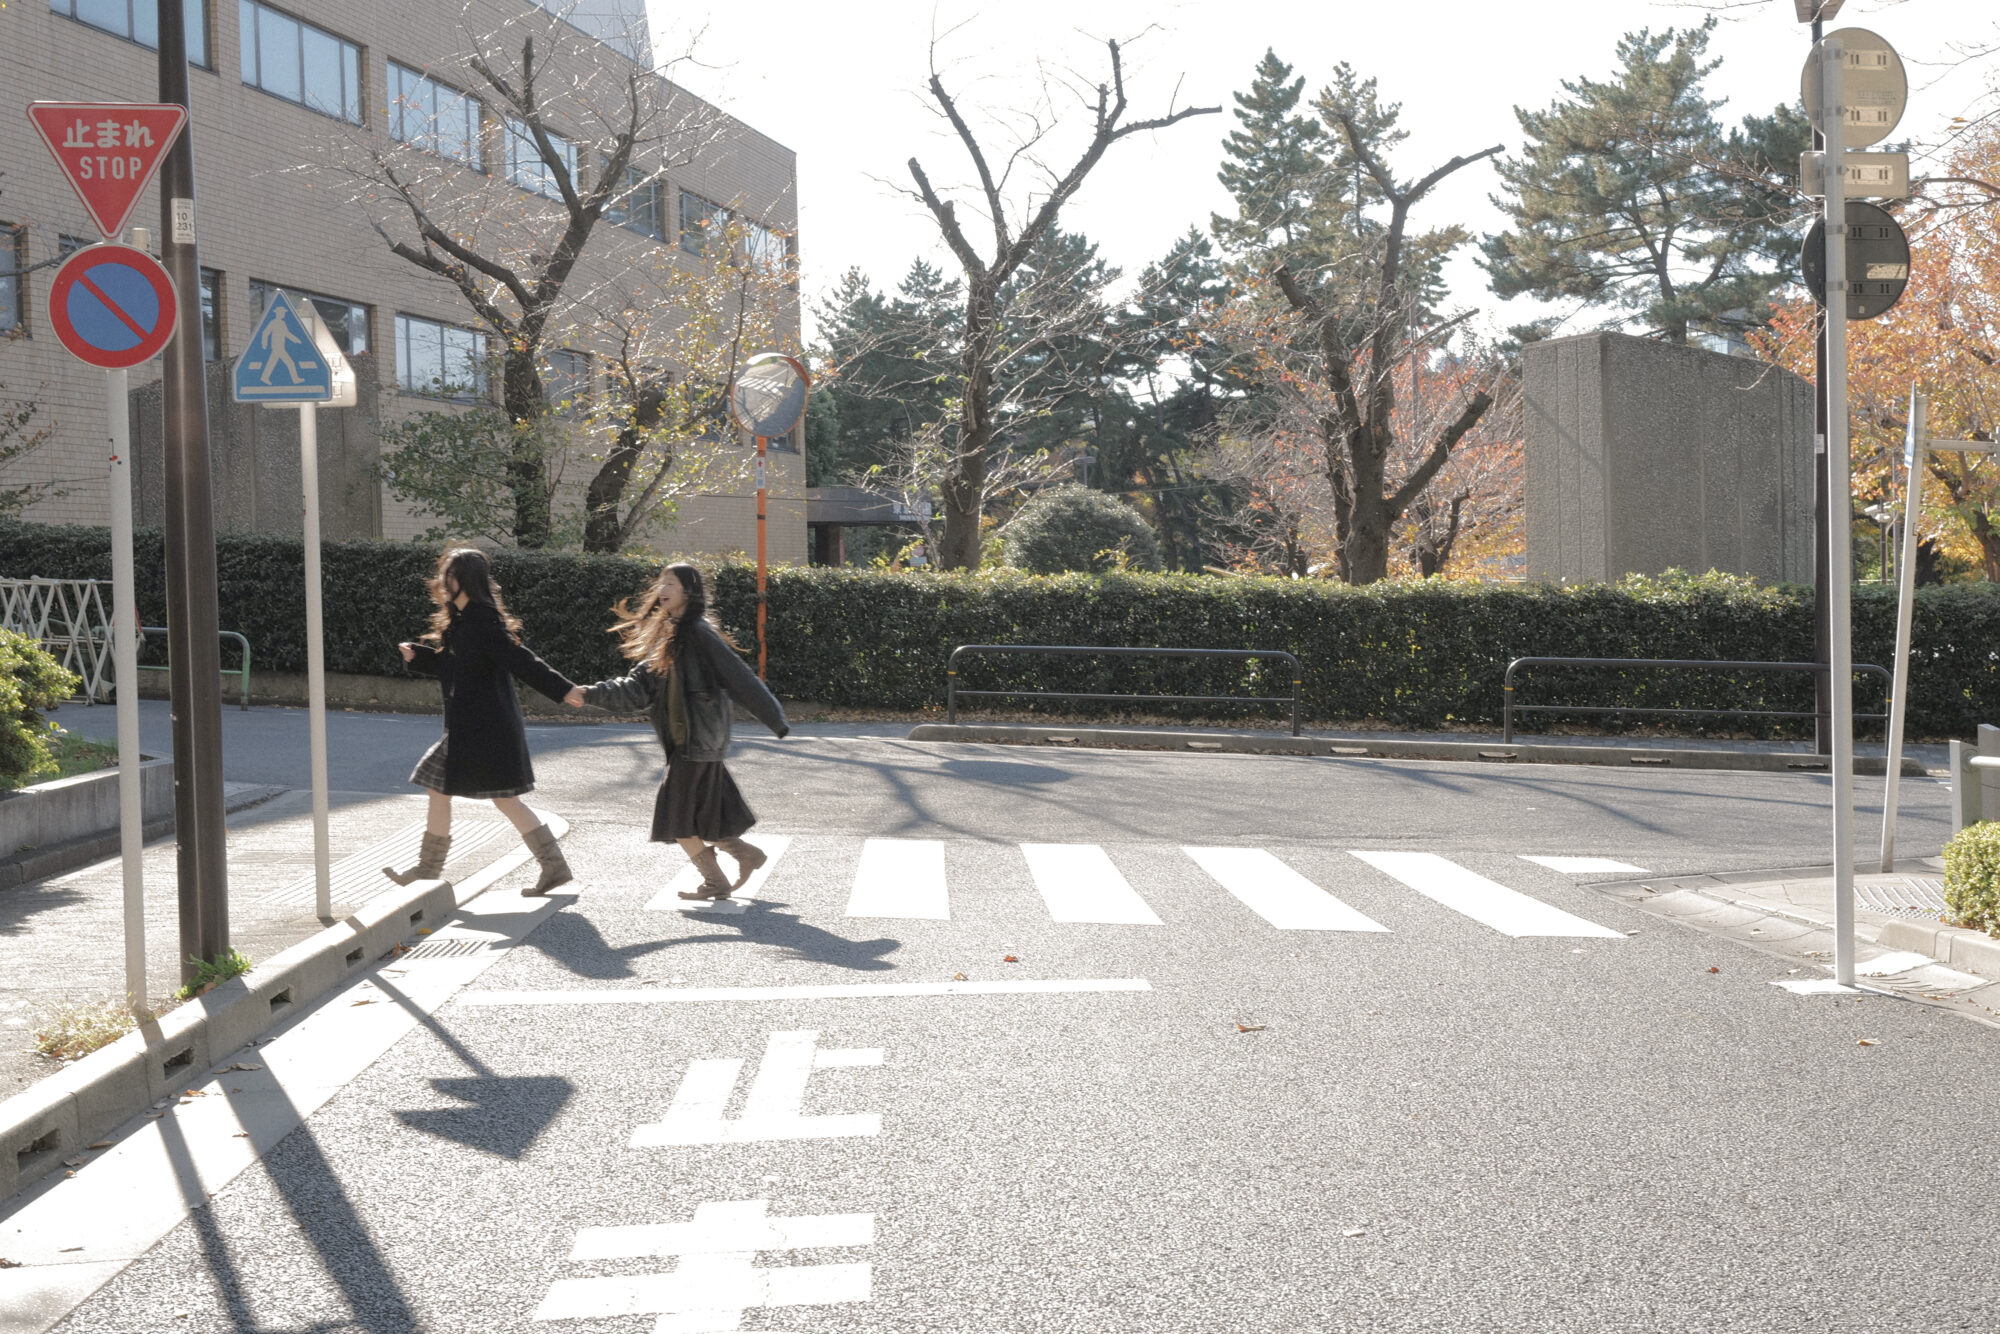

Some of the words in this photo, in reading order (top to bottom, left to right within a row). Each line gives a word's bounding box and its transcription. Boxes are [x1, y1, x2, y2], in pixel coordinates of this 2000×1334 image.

[62, 119, 155, 149] 止まれ
[80, 156, 142, 180] STOP
[176, 212, 188, 221] 10
[176, 222, 192, 231] 231
